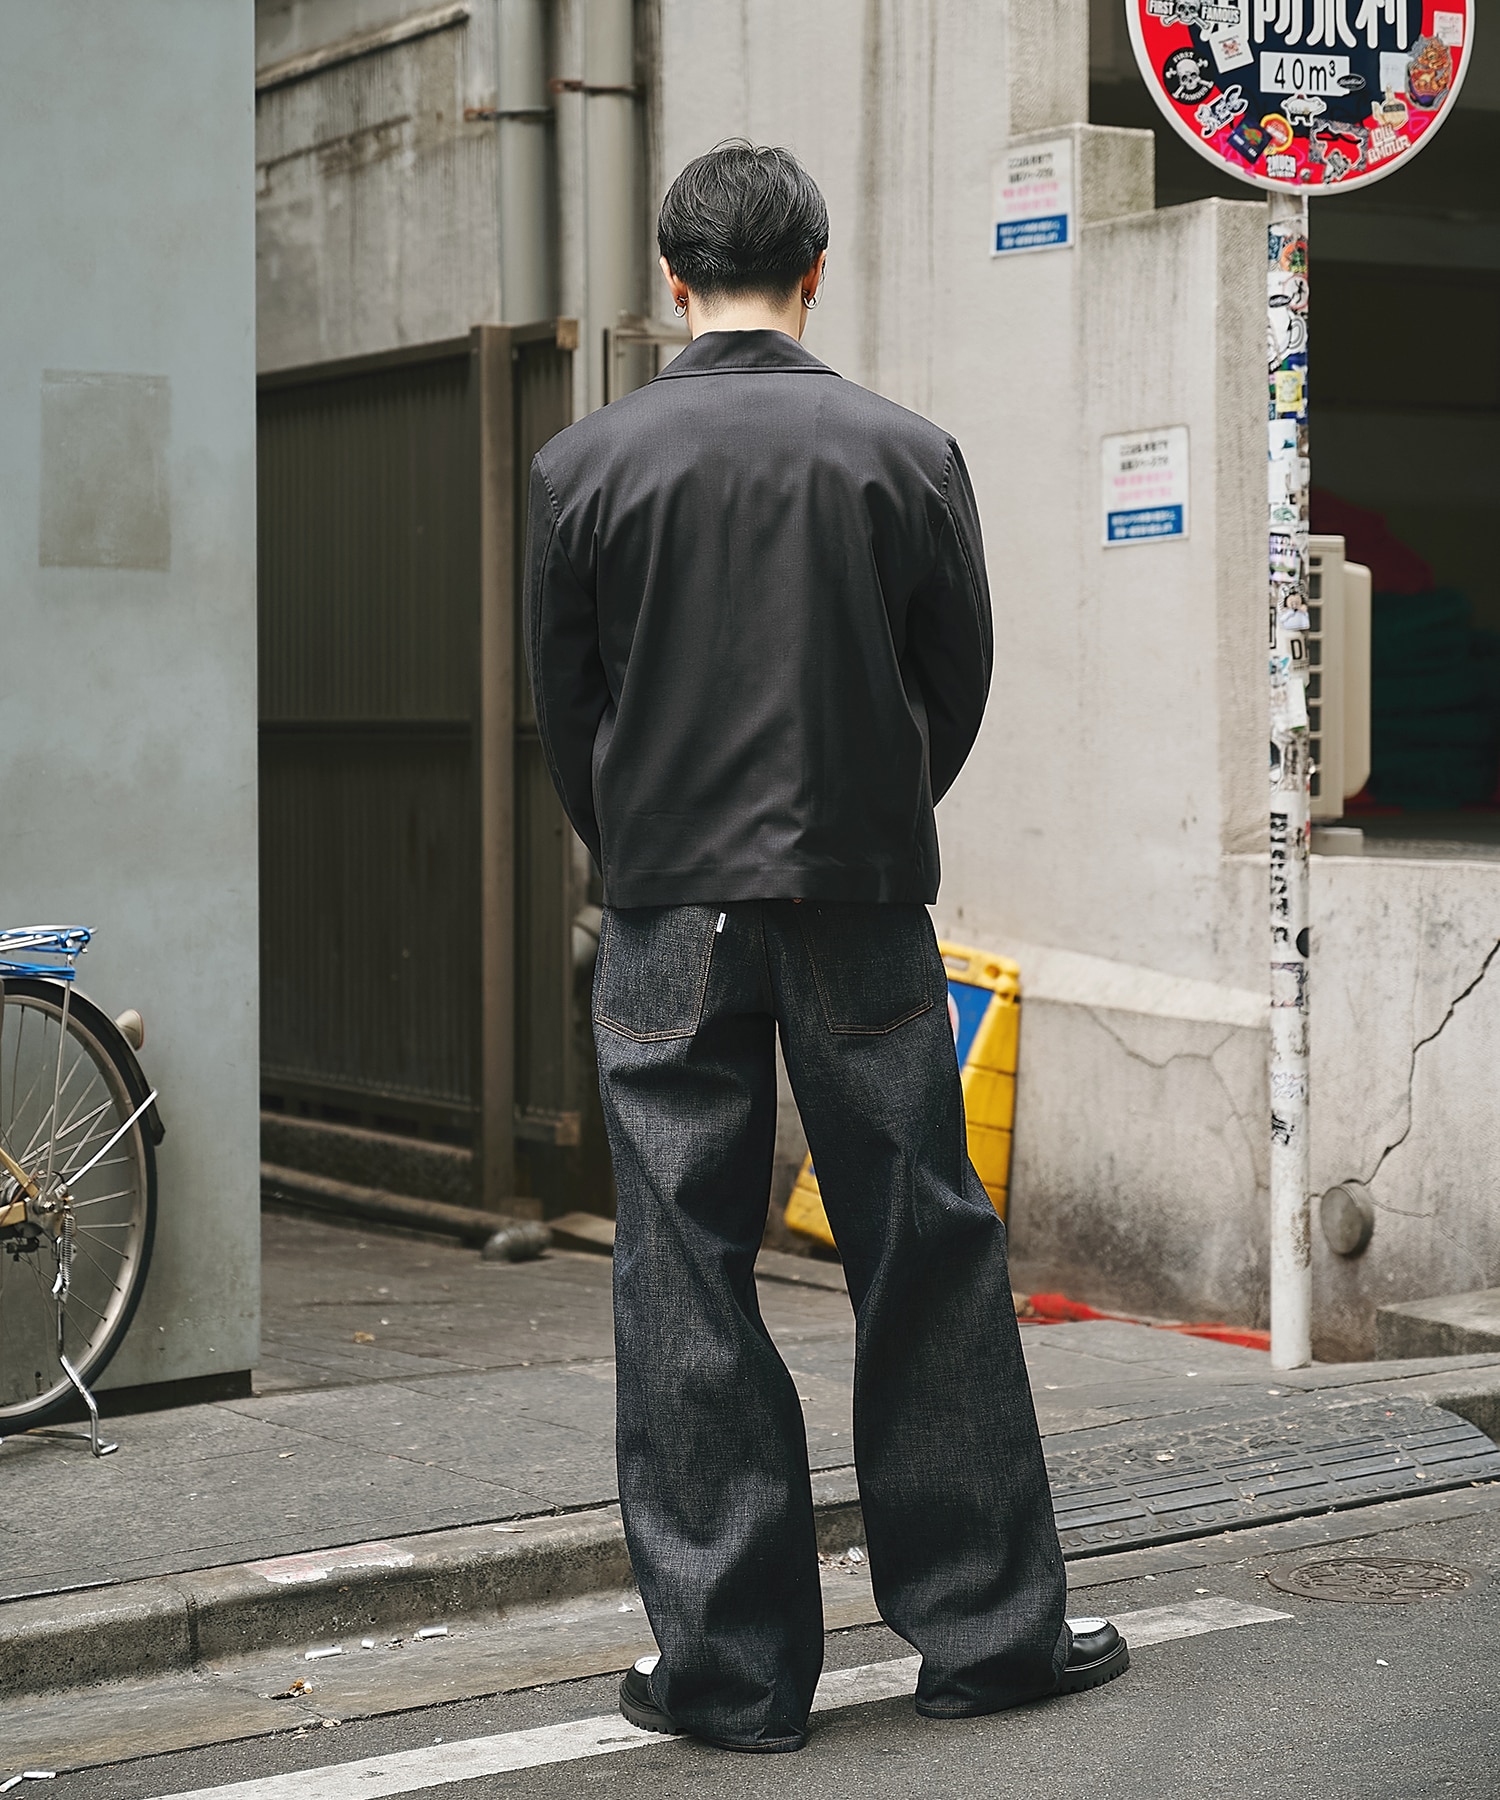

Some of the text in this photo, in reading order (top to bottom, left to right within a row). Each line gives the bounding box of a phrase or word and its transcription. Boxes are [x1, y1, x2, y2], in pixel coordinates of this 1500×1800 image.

[1149, 1, 1240, 23] FIRST FAMOUS
[1173, 51, 1194, 62] FIRST
